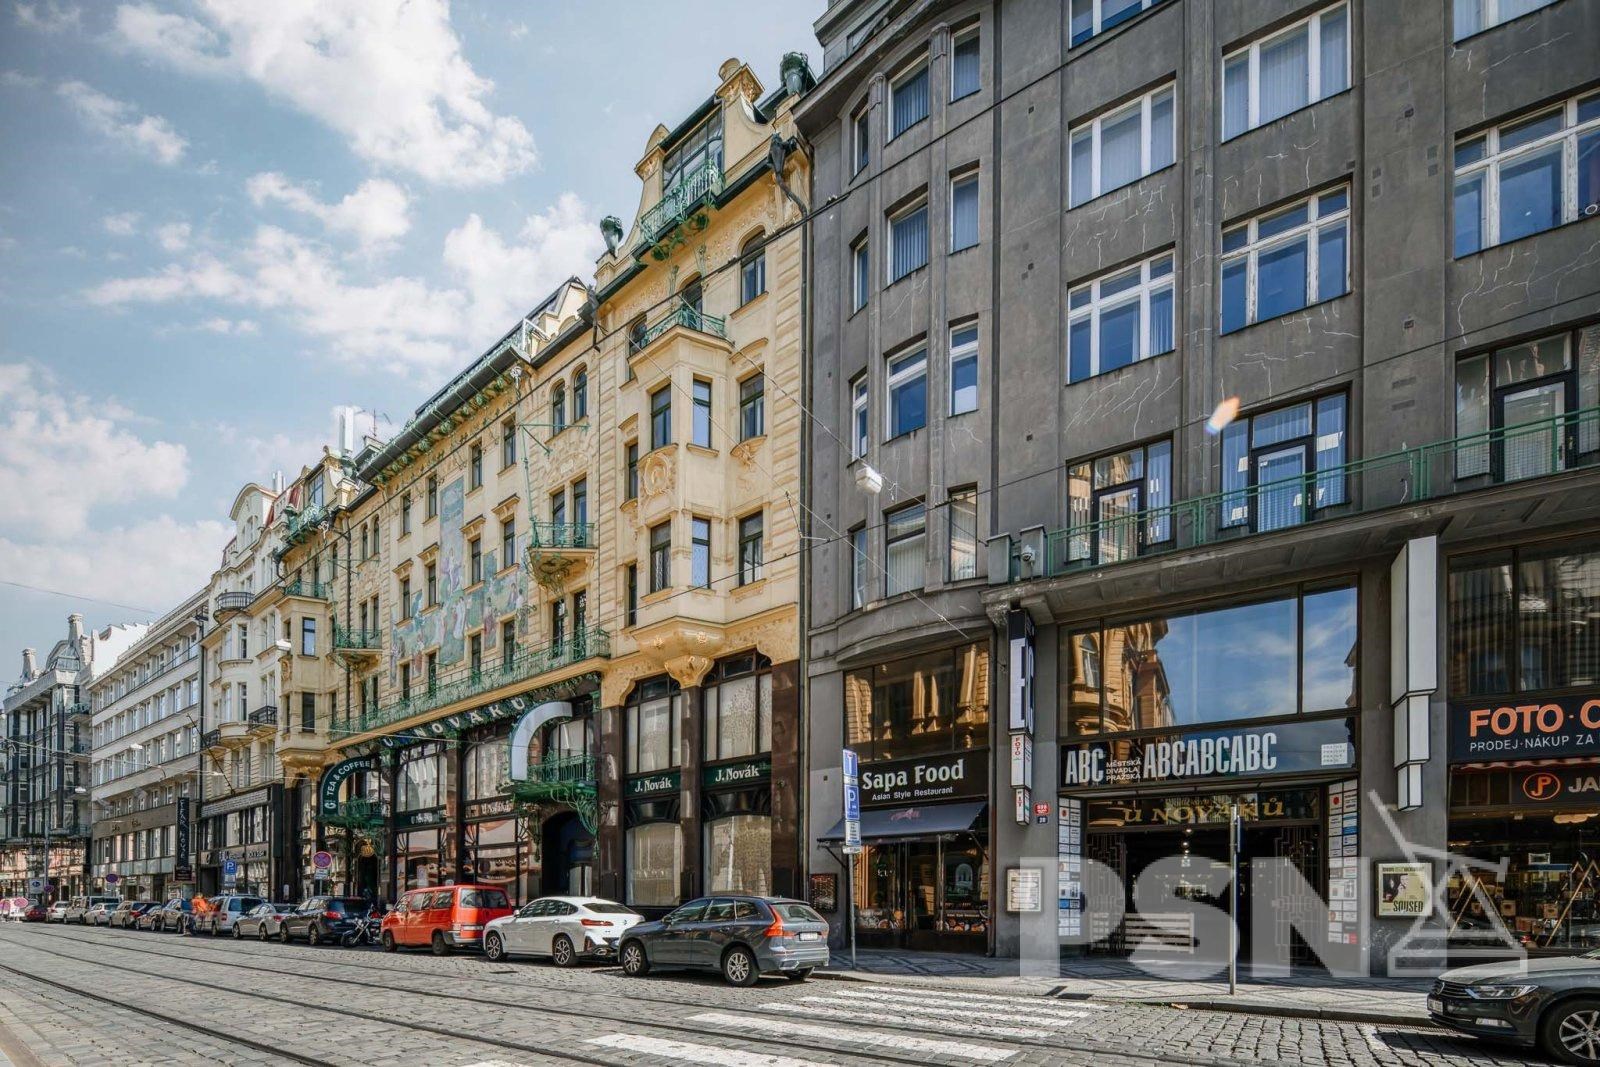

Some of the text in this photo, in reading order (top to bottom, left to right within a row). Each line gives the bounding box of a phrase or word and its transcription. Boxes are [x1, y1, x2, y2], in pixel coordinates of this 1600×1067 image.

[1470, 703, 1564, 737] FOTO
[1575, 734, 1594, 746] ZA
[1065, 748, 1105, 785] ABC
[1143, 732, 1277, 779] ABCABCABC
[326, 781, 337, 796] TEA
[338, 760, 371, 775] COFFEE
[715, 764, 760, 782] J. Novák
[862, 758, 964, 792] Sapa Food
[634, 776, 672, 793] J. Novák
[1568, 776, 1600, 793] JA
[872, 786, 953, 801] Asian Style Restaurant
[1393, 900, 1424, 913] SOUSED
